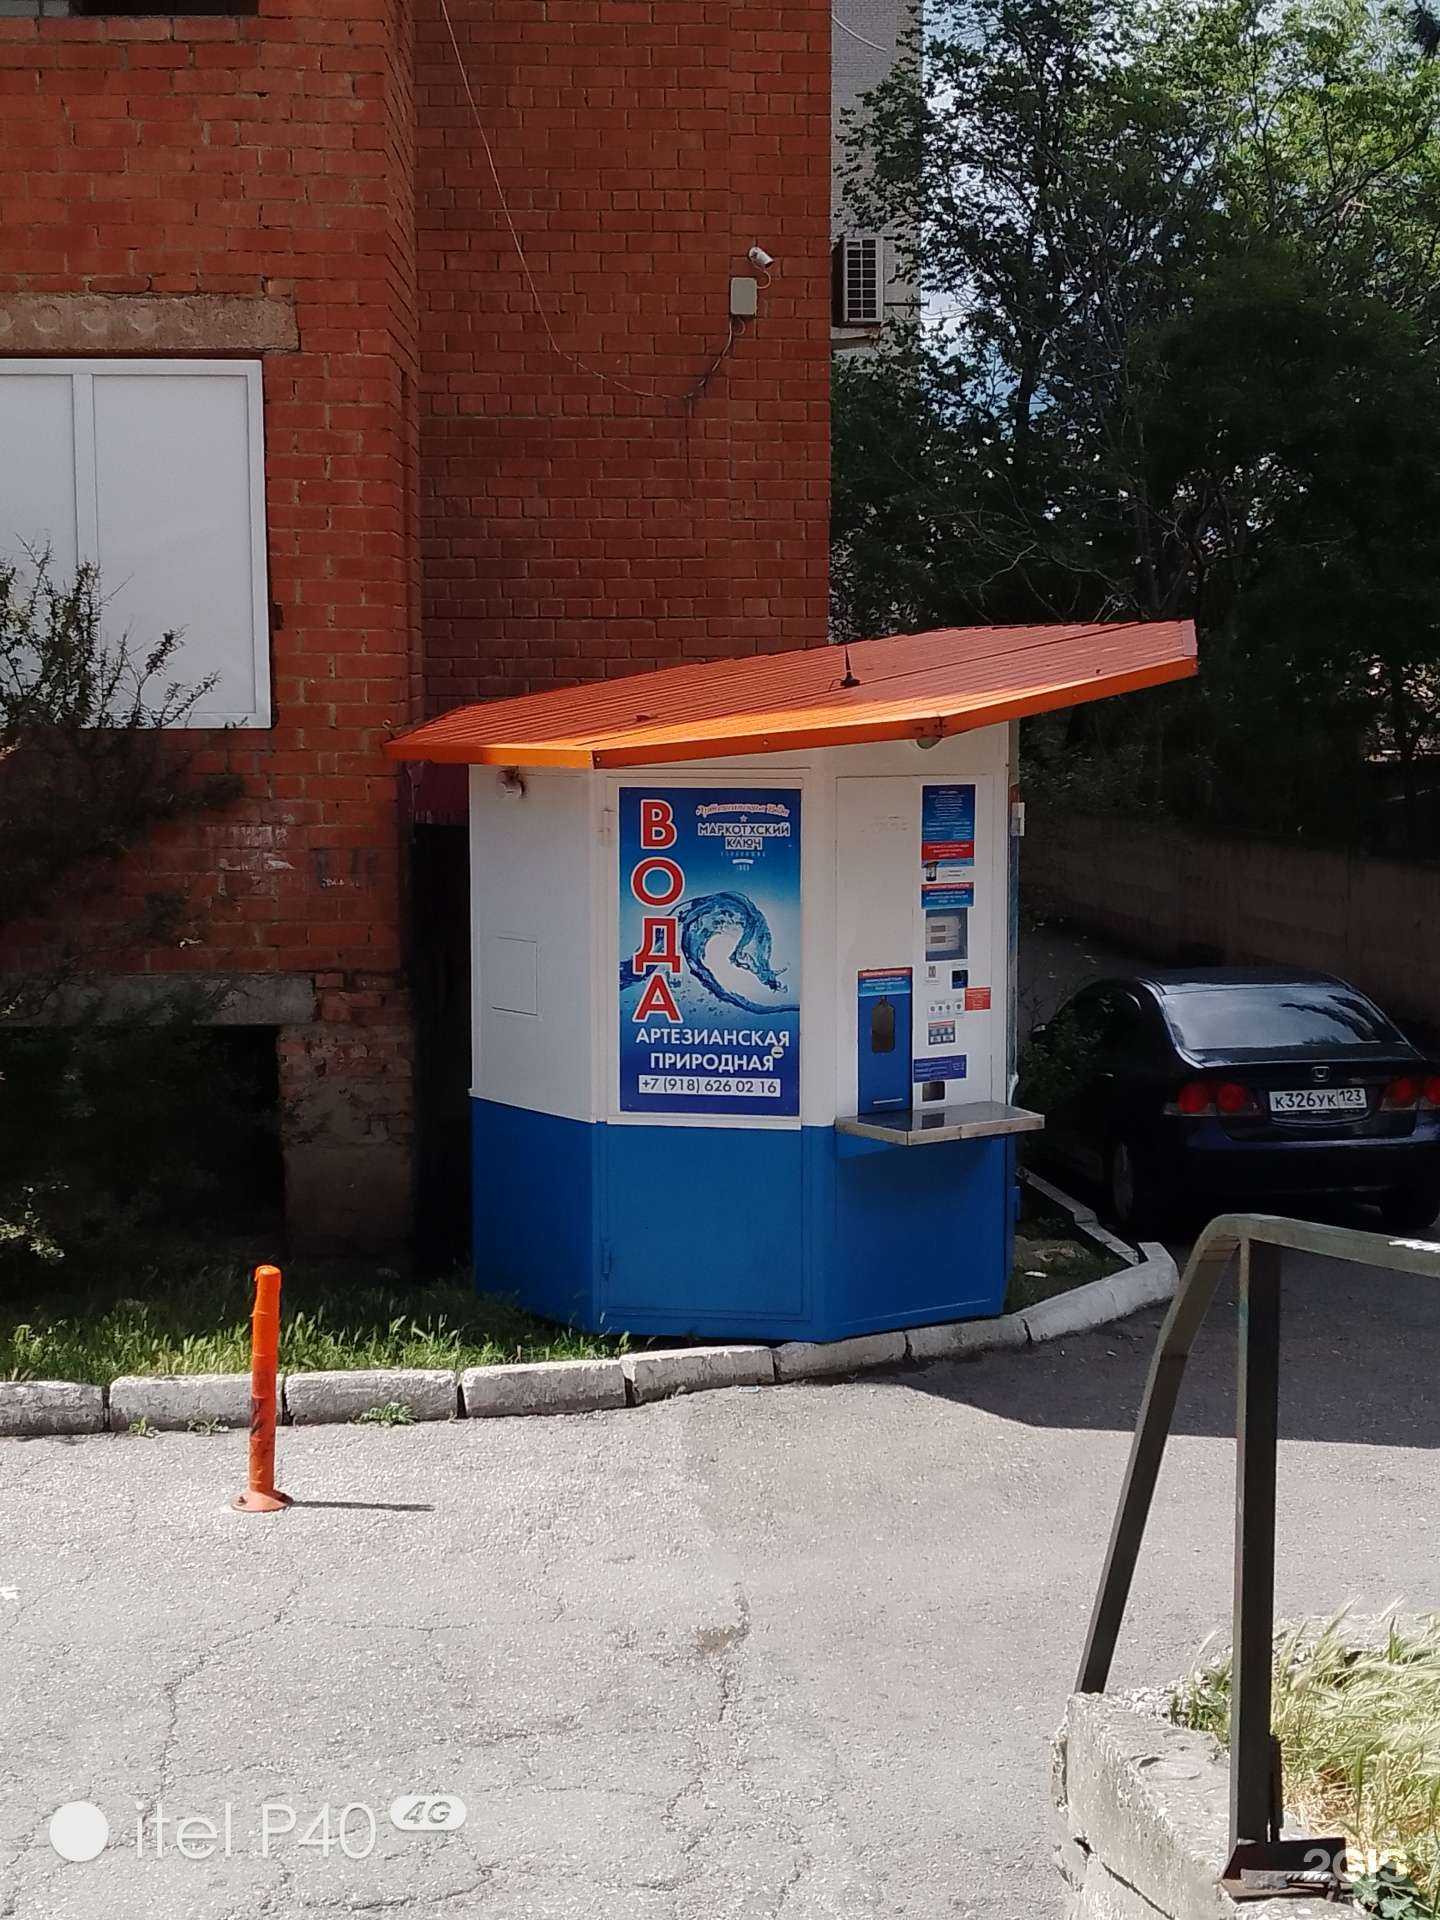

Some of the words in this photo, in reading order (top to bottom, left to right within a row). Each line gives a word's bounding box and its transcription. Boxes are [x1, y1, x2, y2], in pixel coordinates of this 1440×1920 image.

[698, 822, 790, 838] МАРКОТХСКИЙ
[725, 836, 763, 850] КЛЮЧ
[630, 799, 686, 1024] ВОДА
[636, 1028, 789, 1046] АРТЕЗИАНСКАЯ
[650, 1053, 774, 1073] ПРИРОДНАЯ
[641, 1078, 659, 1090] +7
[663, 1078, 700, 1093] (918)
[704, 1079, 732, 1092] 626
[736, 1080, 753, 1093] 02
[760, 1081, 777, 1094] 16
[1339, 1089, 1362, 1102] 123
